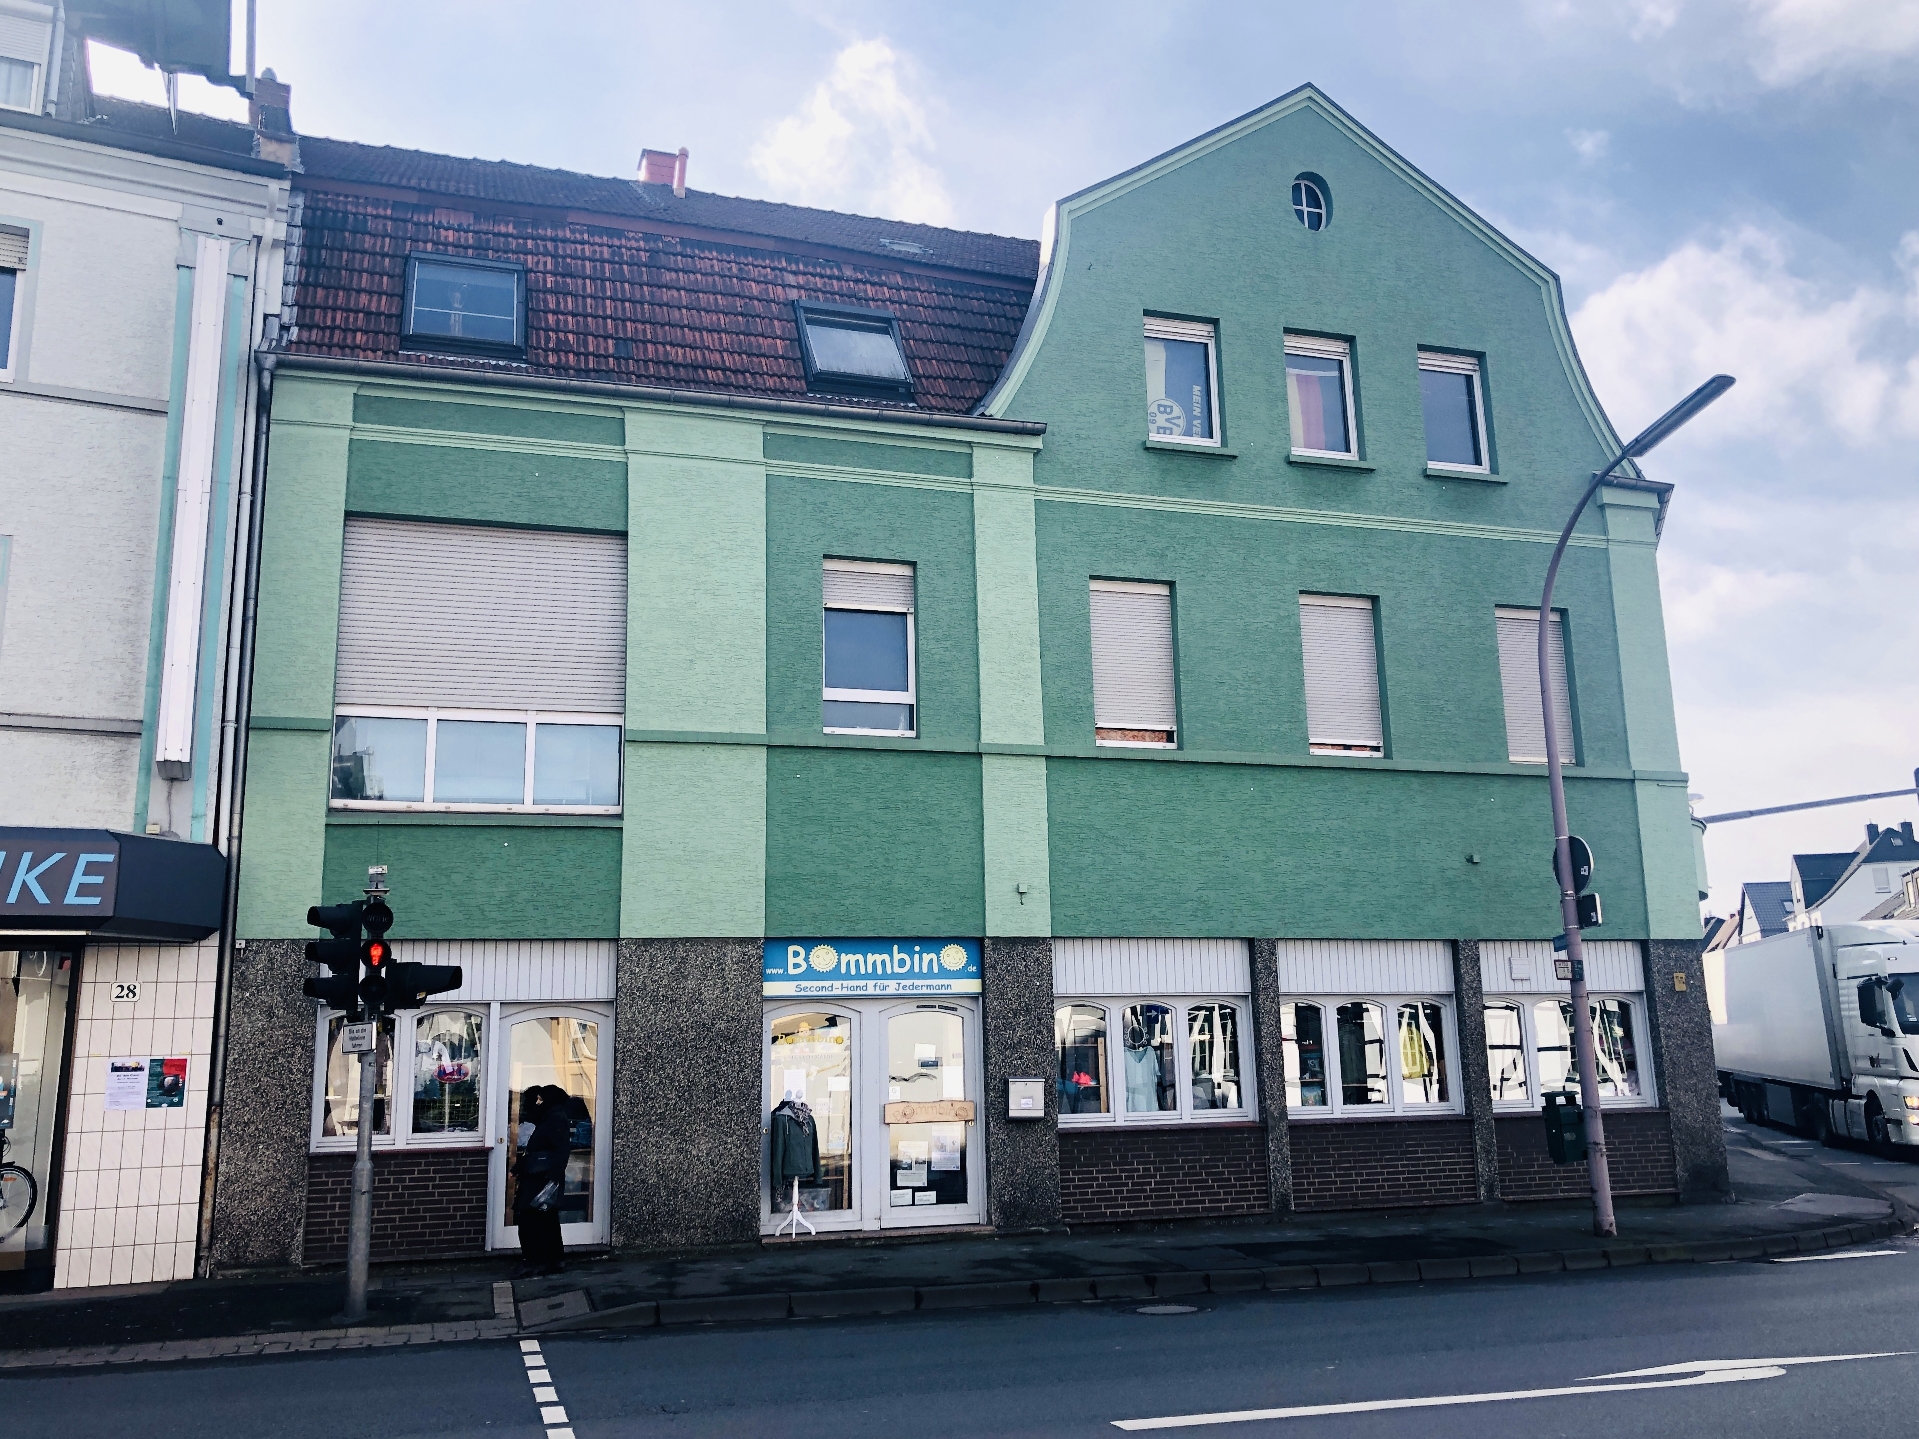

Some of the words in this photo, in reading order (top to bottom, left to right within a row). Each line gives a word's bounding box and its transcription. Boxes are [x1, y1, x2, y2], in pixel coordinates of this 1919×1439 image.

[1193, 385, 1201, 416] MEIN
[1149, 412, 1157, 424] 09
[0, 851, 115, 905] KE
[114, 983, 137, 999] 28
[795, 982, 868, 993] Second-Hand
[873, 982, 889, 992] für
[894, 981, 952, 992] Jedermann
